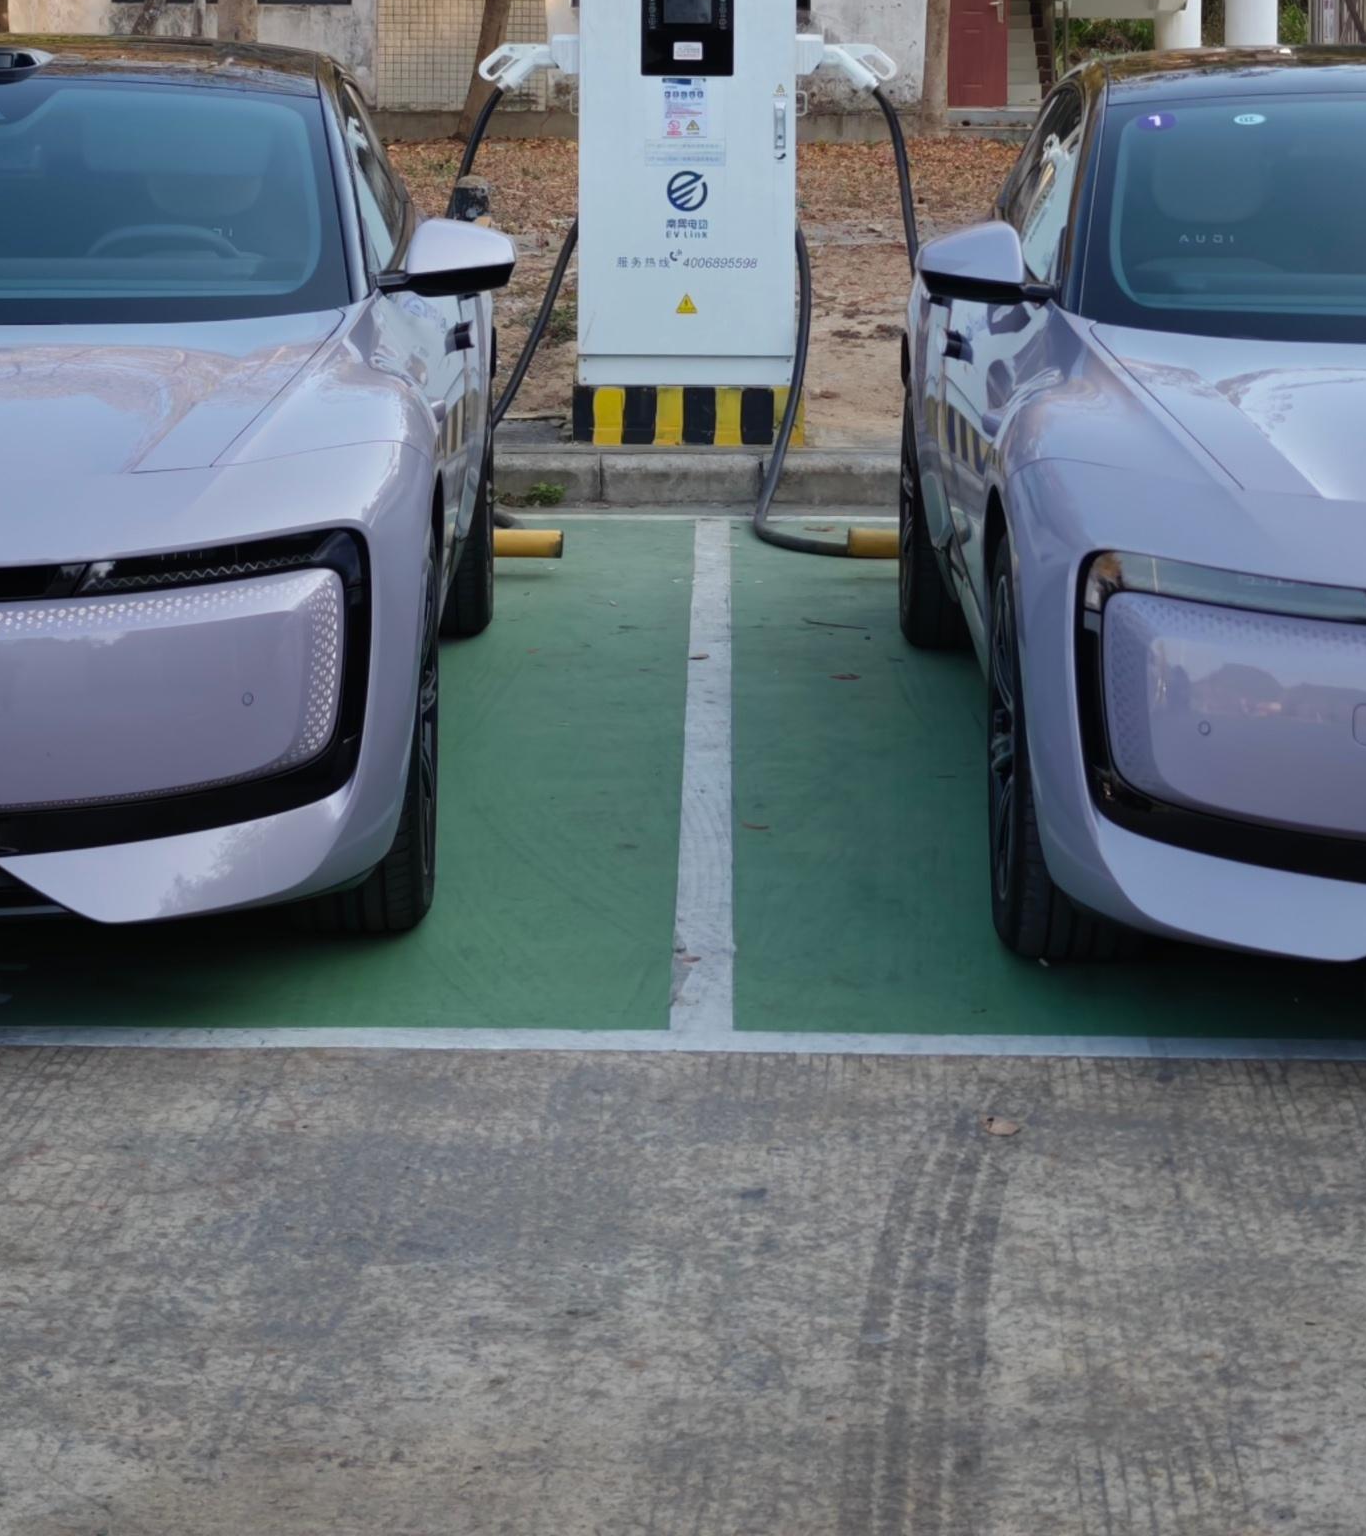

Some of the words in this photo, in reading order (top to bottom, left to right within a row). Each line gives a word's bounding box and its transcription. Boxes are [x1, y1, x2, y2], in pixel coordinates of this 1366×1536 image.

[666, 218, 709, 230] 南网电动
[666, 230, 680, 239] EV
[1178, 234, 1235, 244] AUDI
[616, 256, 671, 269] 服务热线
[682, 257, 759, 269] 4006895598
